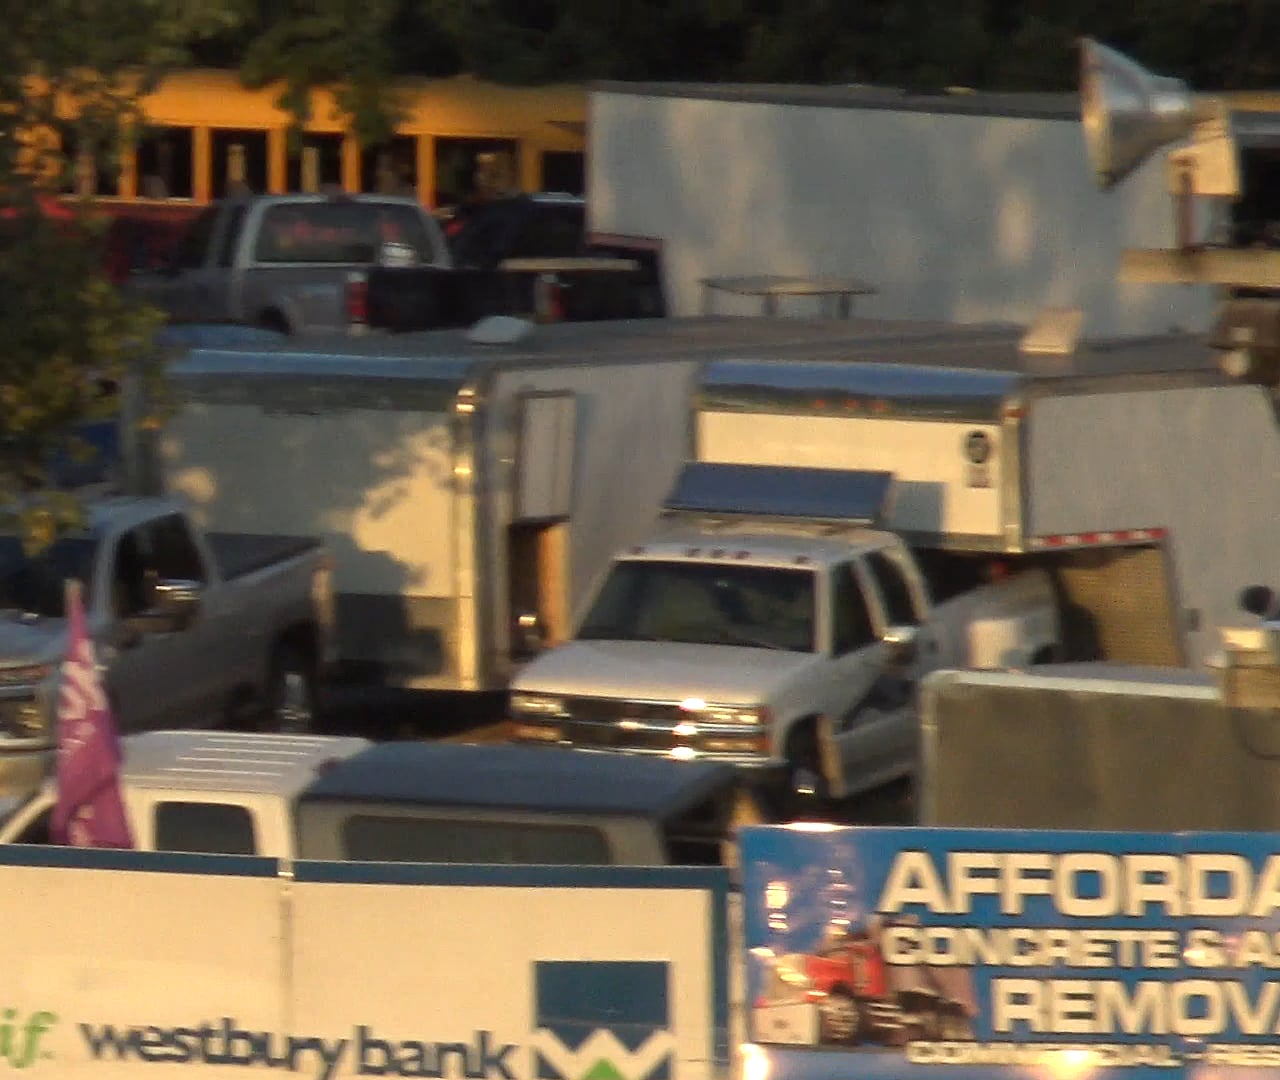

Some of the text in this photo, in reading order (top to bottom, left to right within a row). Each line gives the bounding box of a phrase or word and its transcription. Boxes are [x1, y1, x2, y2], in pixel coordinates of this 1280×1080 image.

[881, 927, 1181, 968] CONCRETE
[1184, 928, 1226, 969] &
[991, 977, 1280, 1035] REMOV
[907, 1040, 1183, 1068] COMMCIAL
